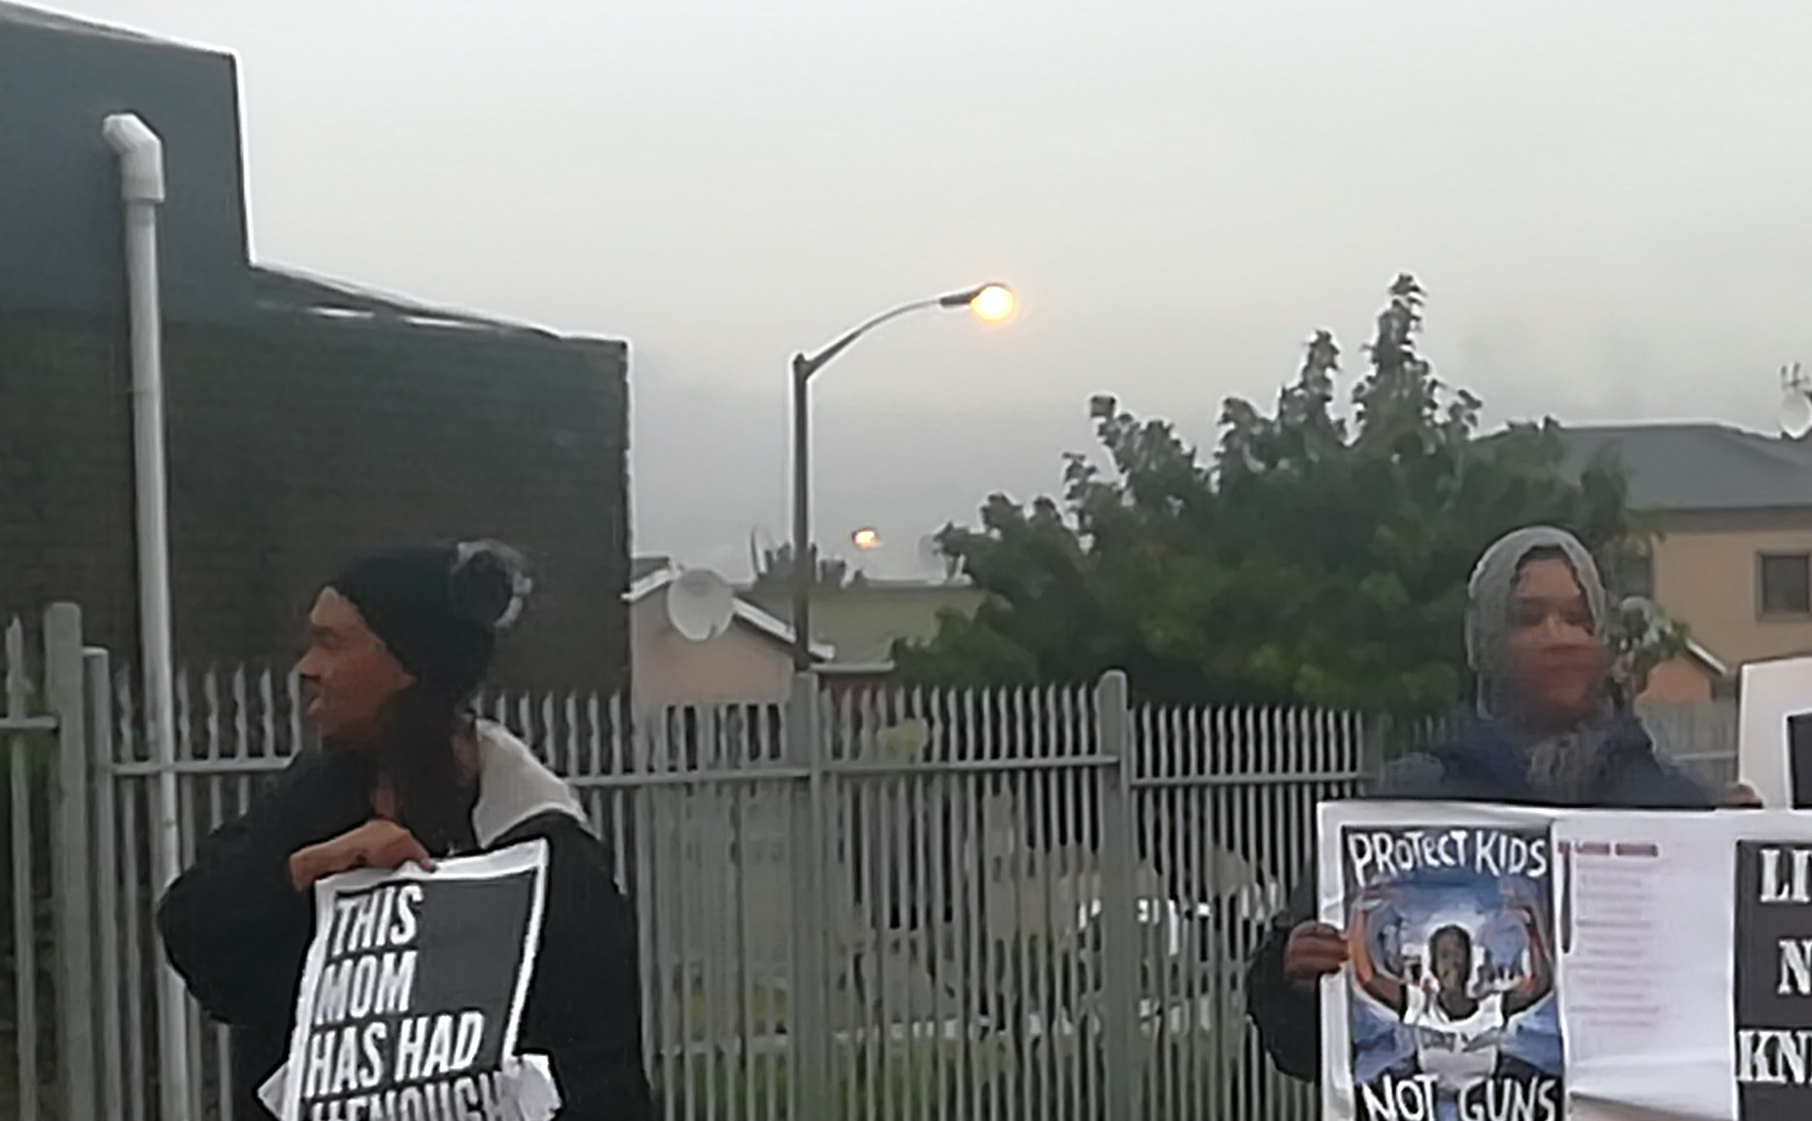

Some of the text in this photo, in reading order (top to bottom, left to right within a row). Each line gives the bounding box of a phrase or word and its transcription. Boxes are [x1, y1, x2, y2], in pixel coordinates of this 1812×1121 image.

[1475, 829, 1548, 878] KIDS
[331, 885, 422, 956] THIS
[315, 951, 417, 1025] MOM
[306, 1011, 484, 1098] HAS HAD
